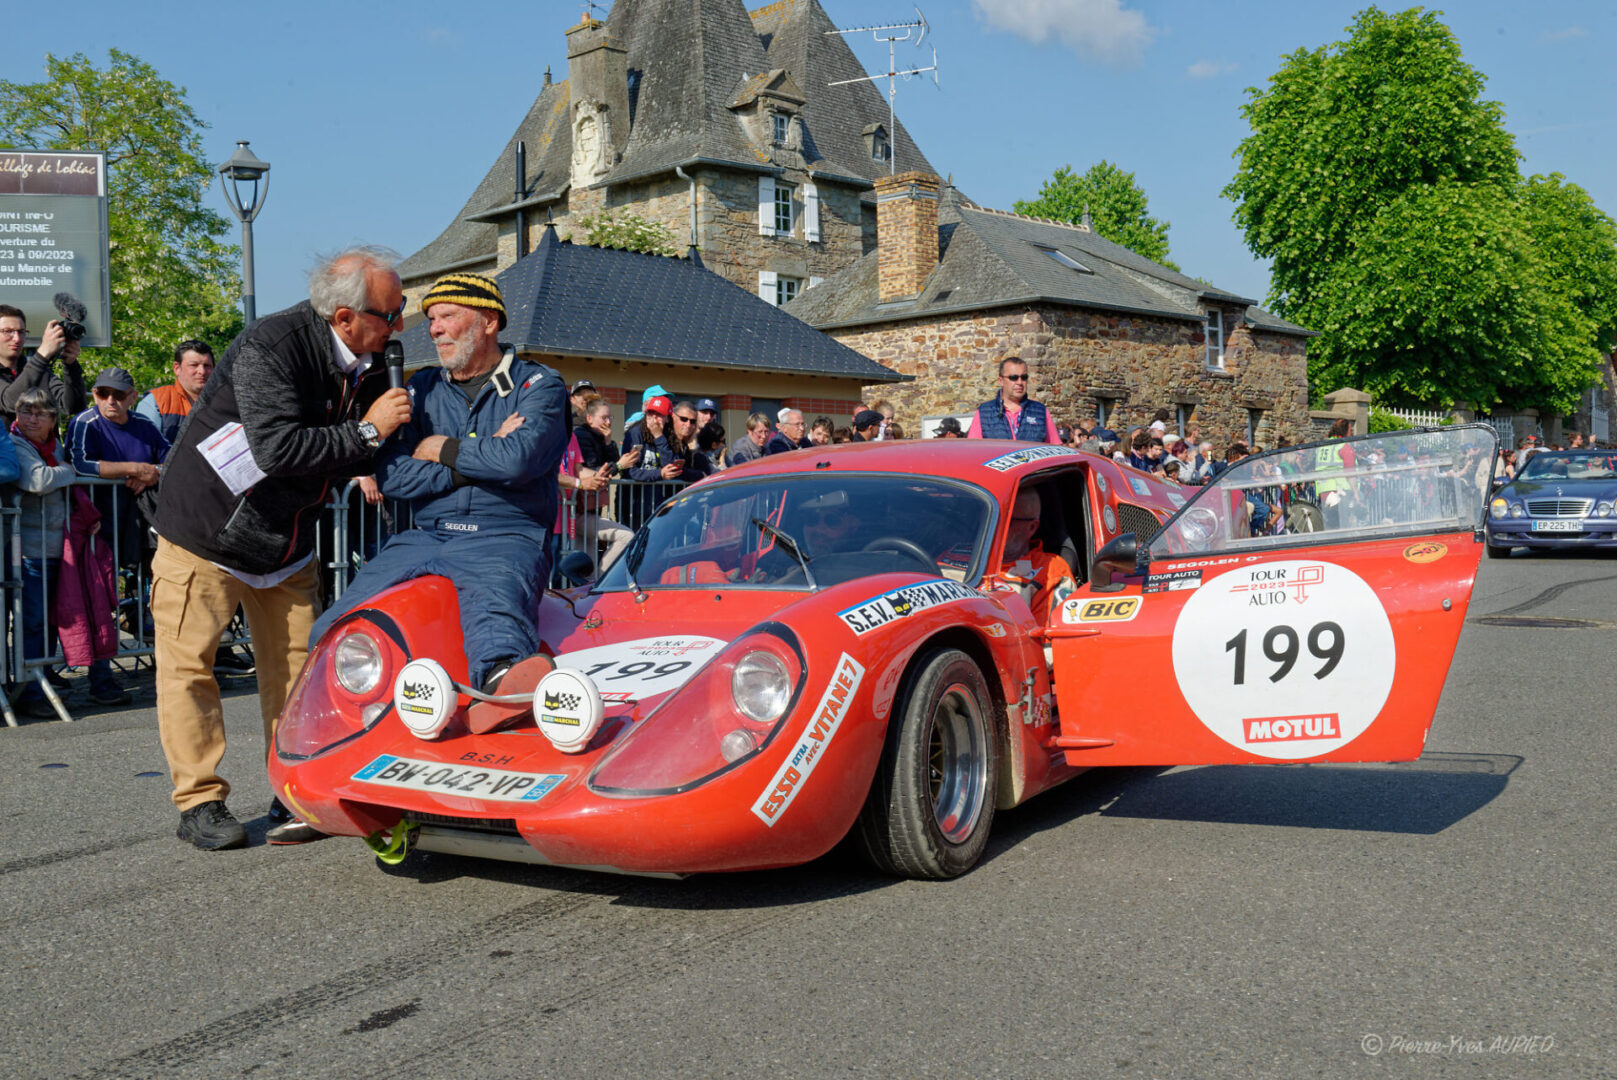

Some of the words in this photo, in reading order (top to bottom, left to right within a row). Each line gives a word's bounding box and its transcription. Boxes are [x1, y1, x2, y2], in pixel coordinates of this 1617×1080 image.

[37, 160, 52, 173] de
[41, 237, 55, 246] du
[18, 263, 56, 273] Manoir
[58, 263, 72, 273] de
[444, 522, 478, 532] SEGOLEN
[1167, 557, 1240, 570] SEGOLEN
[1149, 572, 1172, 581] TOUR
[1173, 570, 1200, 578] AUTO
[1250, 569, 1287, 582] TOUR
[1250, 581, 1285, 591] 2023
[1249, 590, 1286, 606] AUTO
[1225, 620, 1346, 686] 199
[584, 660, 693, 681] 199
[1249, 716, 1336, 741] MOTUL
[376, 761, 537, 797] BW-042-VP
[760, 765, 802, 818] ESSO
[805, 741, 820, 765] AVEC
